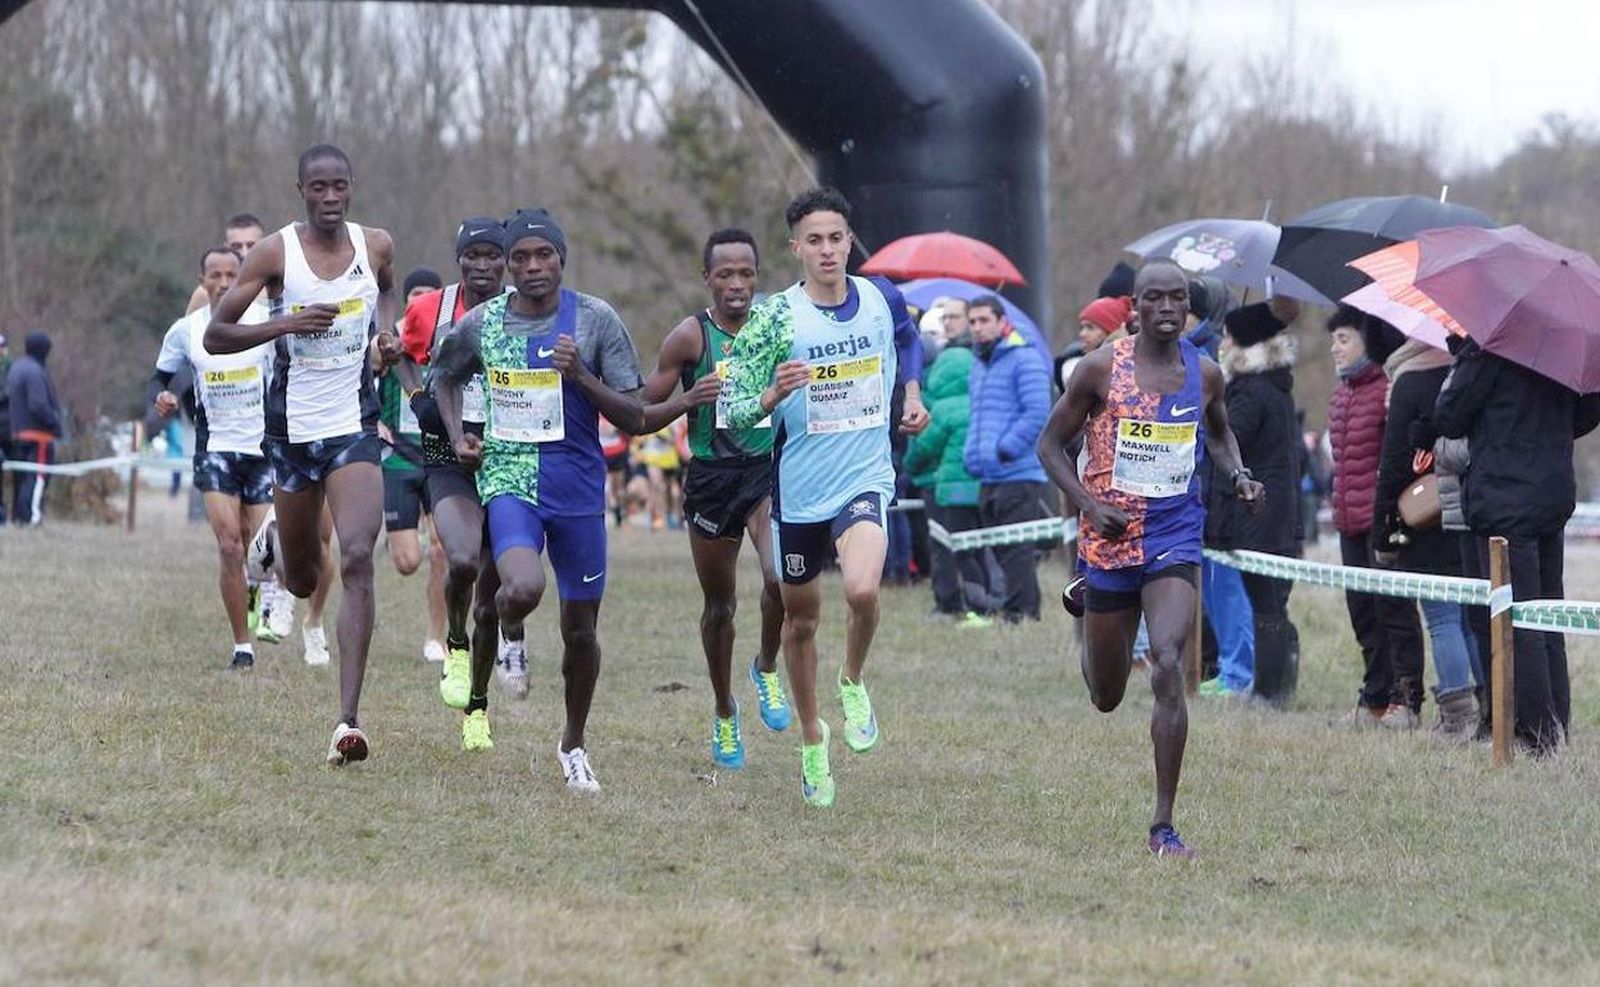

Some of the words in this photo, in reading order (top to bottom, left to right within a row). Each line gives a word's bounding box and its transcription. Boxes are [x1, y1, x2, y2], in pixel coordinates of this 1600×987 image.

[808, 334, 872, 360] nerja
[494, 370, 510, 385] 26
[816, 364, 838, 380] 26
[542, 419, 552, 431] 2
[1129, 422, 1153, 438] 26
[1121, 440, 1171, 453] MAXWELL
[1119, 451, 1157, 463] ROTICH
